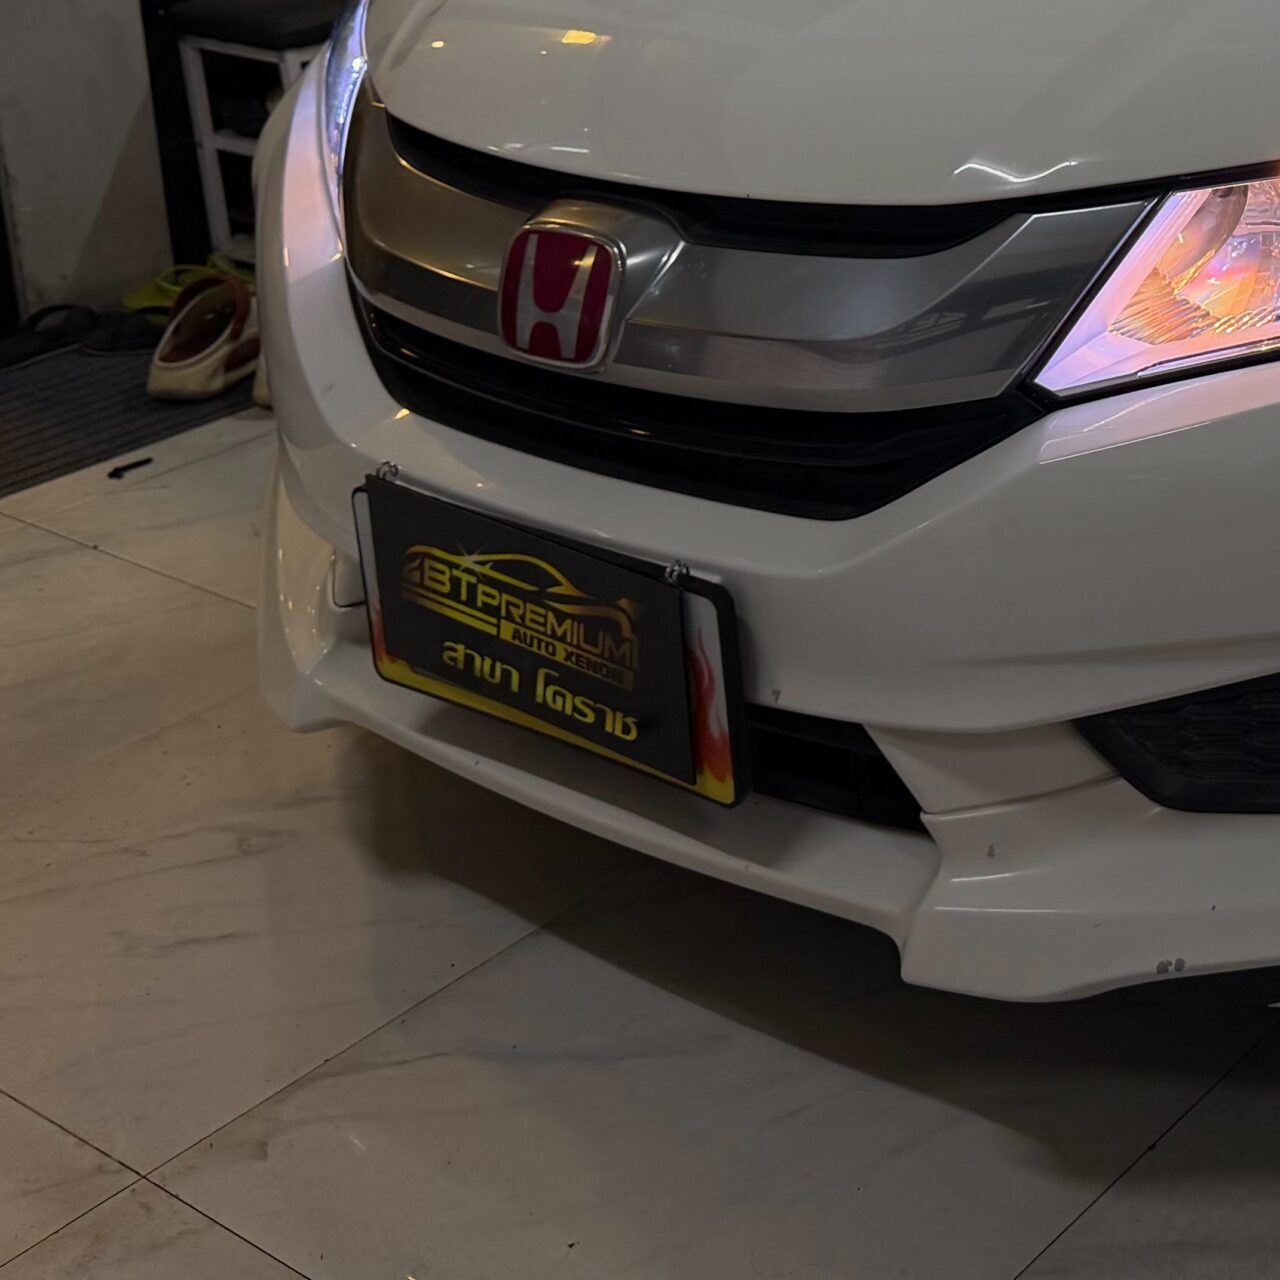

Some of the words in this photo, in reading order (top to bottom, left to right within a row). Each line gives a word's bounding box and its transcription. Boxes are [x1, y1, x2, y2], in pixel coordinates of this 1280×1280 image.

[512, 627, 557, 657] AUTO
[442, 640, 520, 693] สาขา
[535, 667, 639, 742] โคราช
